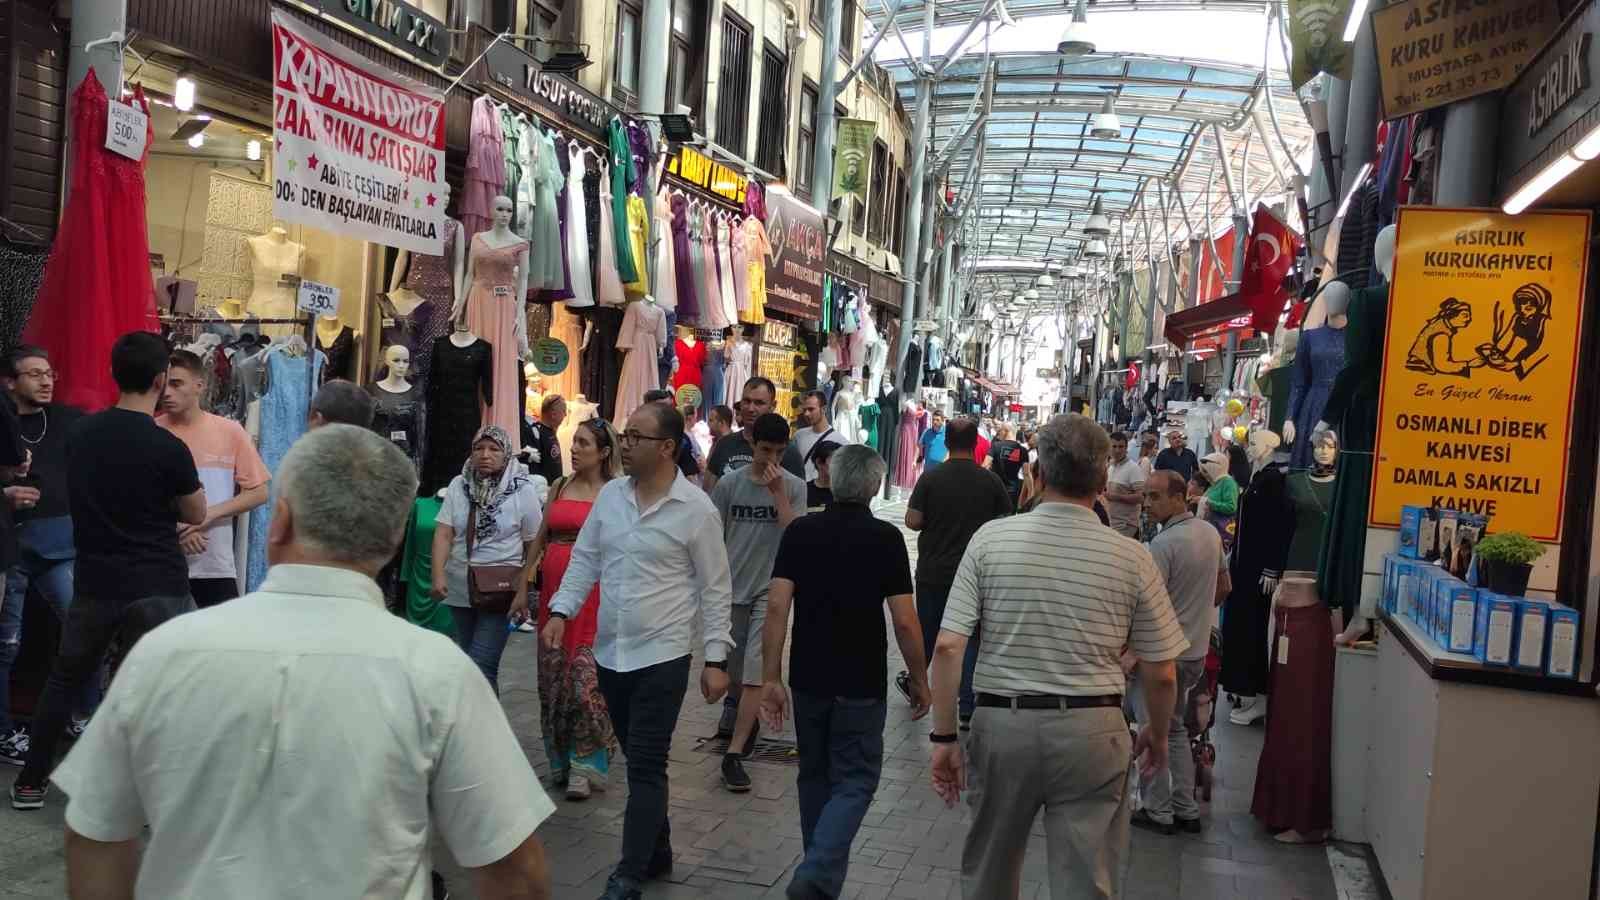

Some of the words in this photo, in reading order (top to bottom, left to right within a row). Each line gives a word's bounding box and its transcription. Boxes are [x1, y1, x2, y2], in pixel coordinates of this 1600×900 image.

[1391, 33, 1445, 67] KURU
[1407, 53, 1483, 84] MUSTAFA
[279, 35, 440, 144] KAPATIYORUZ
[526, 66, 567, 106] YUSUF
[1527, 32, 1584, 137] ASIRLIK
[367, 131, 437, 184] SATIŞLAR
[301, 186, 328, 212] DEN
[328, 195, 384, 224] BAŞLAYAN
[383, 206, 437, 240] FİYATLARLA
[1455, 230, 1526, 247] ASIRLIK
[1414, 383, 1434, 398] En
[1441, 384, 1483, 402] Güzel
[1396, 413, 1482, 435] OSMANLI
[1487, 416, 1549, 440] DİBEK
[1426, 440, 1511, 463] KAHVESİ
[1393, 467, 1458, 488] DAMLA
[1463, 473, 1541, 495] SAKIZLI
[1431, 495, 1497, 516] KAHVE
